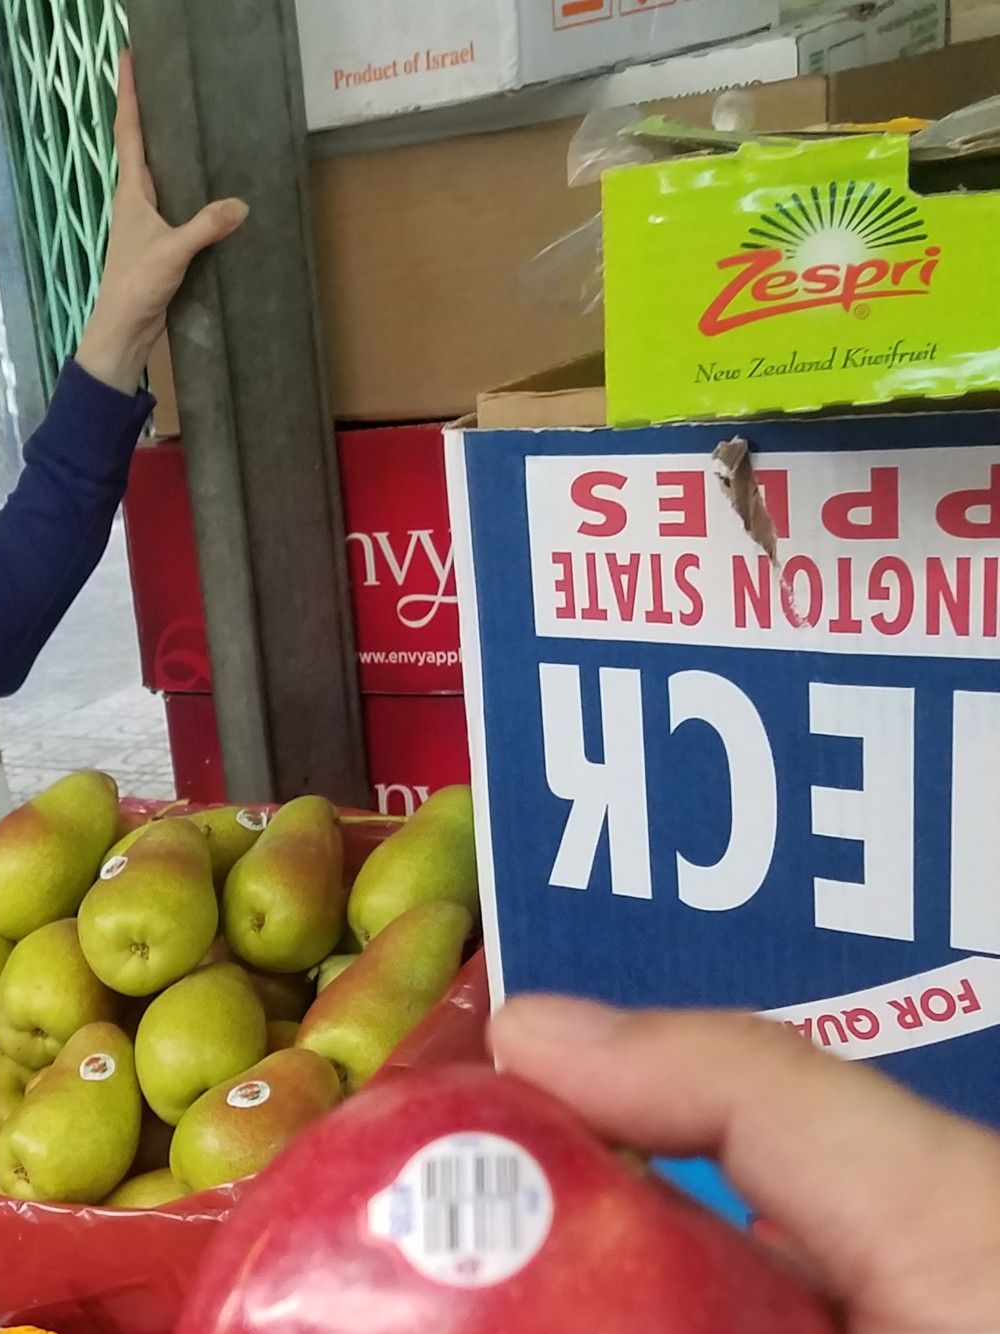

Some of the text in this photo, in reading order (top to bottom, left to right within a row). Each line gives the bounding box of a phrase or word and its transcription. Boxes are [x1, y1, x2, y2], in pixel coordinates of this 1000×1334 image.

[333, 41, 475, 90] Product of Israel
[697, 245, 942, 337] Zespri
[694, 340, 938, 383] New Zealand Kiwifruit
[552, 550, 703, 627] STATE
[887, 978, 981, 1032] FOR
